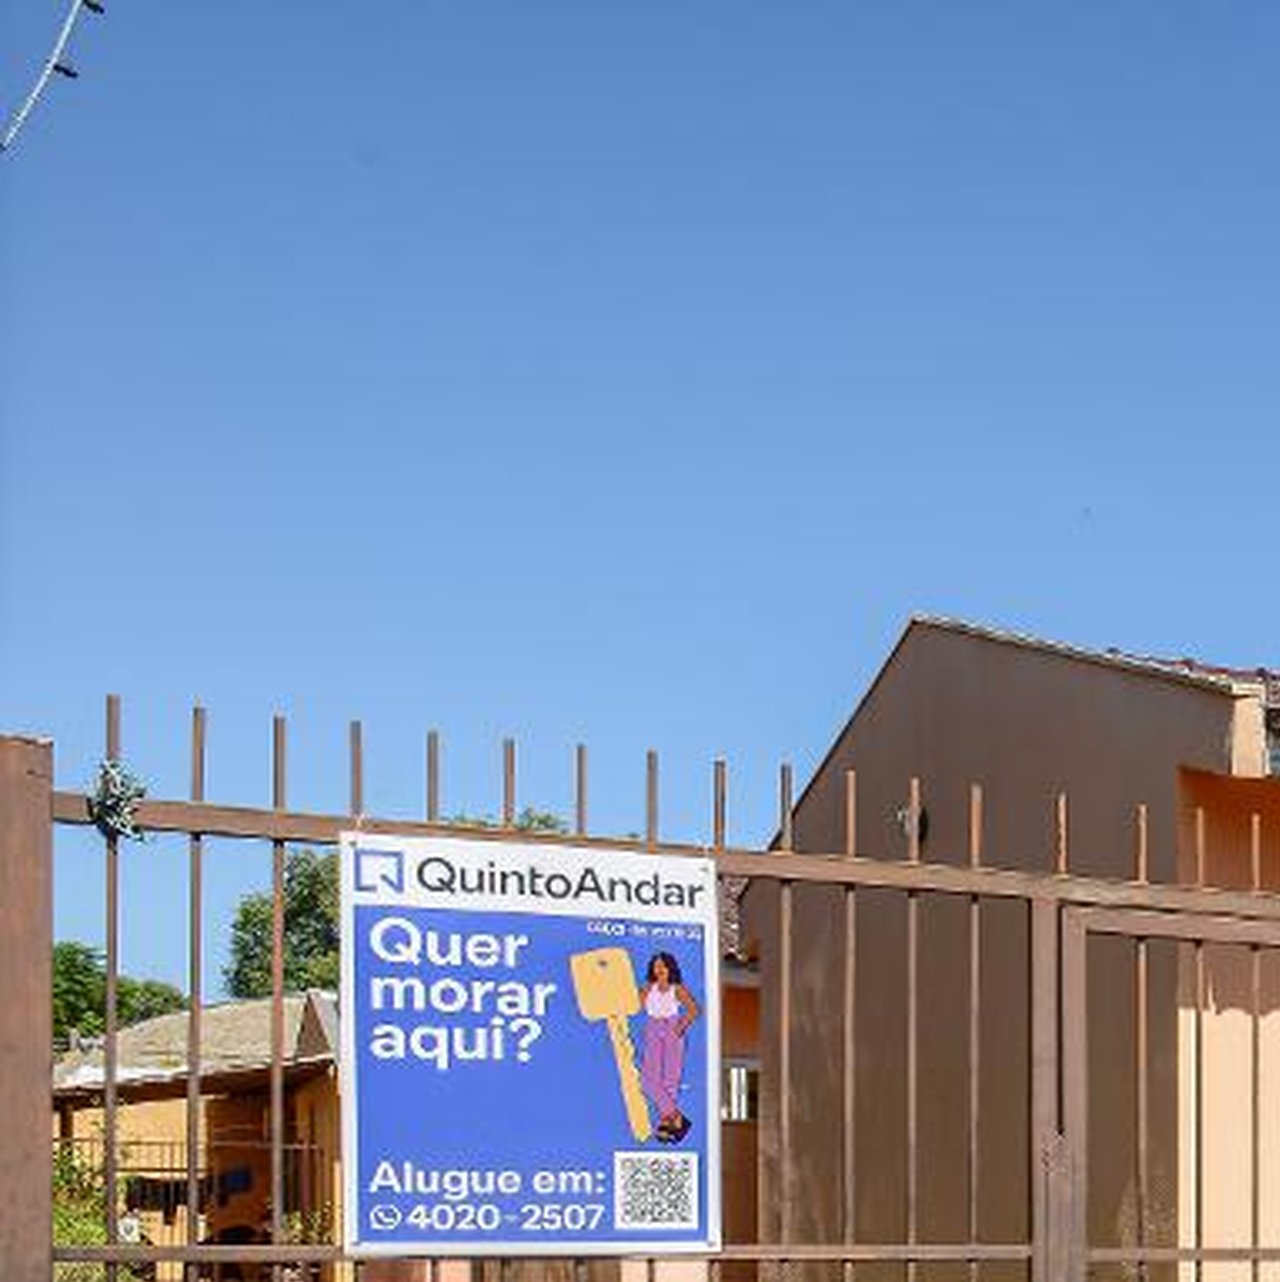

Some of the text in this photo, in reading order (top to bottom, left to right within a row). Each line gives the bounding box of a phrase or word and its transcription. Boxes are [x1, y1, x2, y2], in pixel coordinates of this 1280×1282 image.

[416, 856, 702, 909] QuintoAndar
[369, 917, 528, 967] Quer
[371, 976, 555, 1017] morar
[370, 1017, 541, 1069] aqui?
[369, 1160, 606, 1200] Alugue em:
